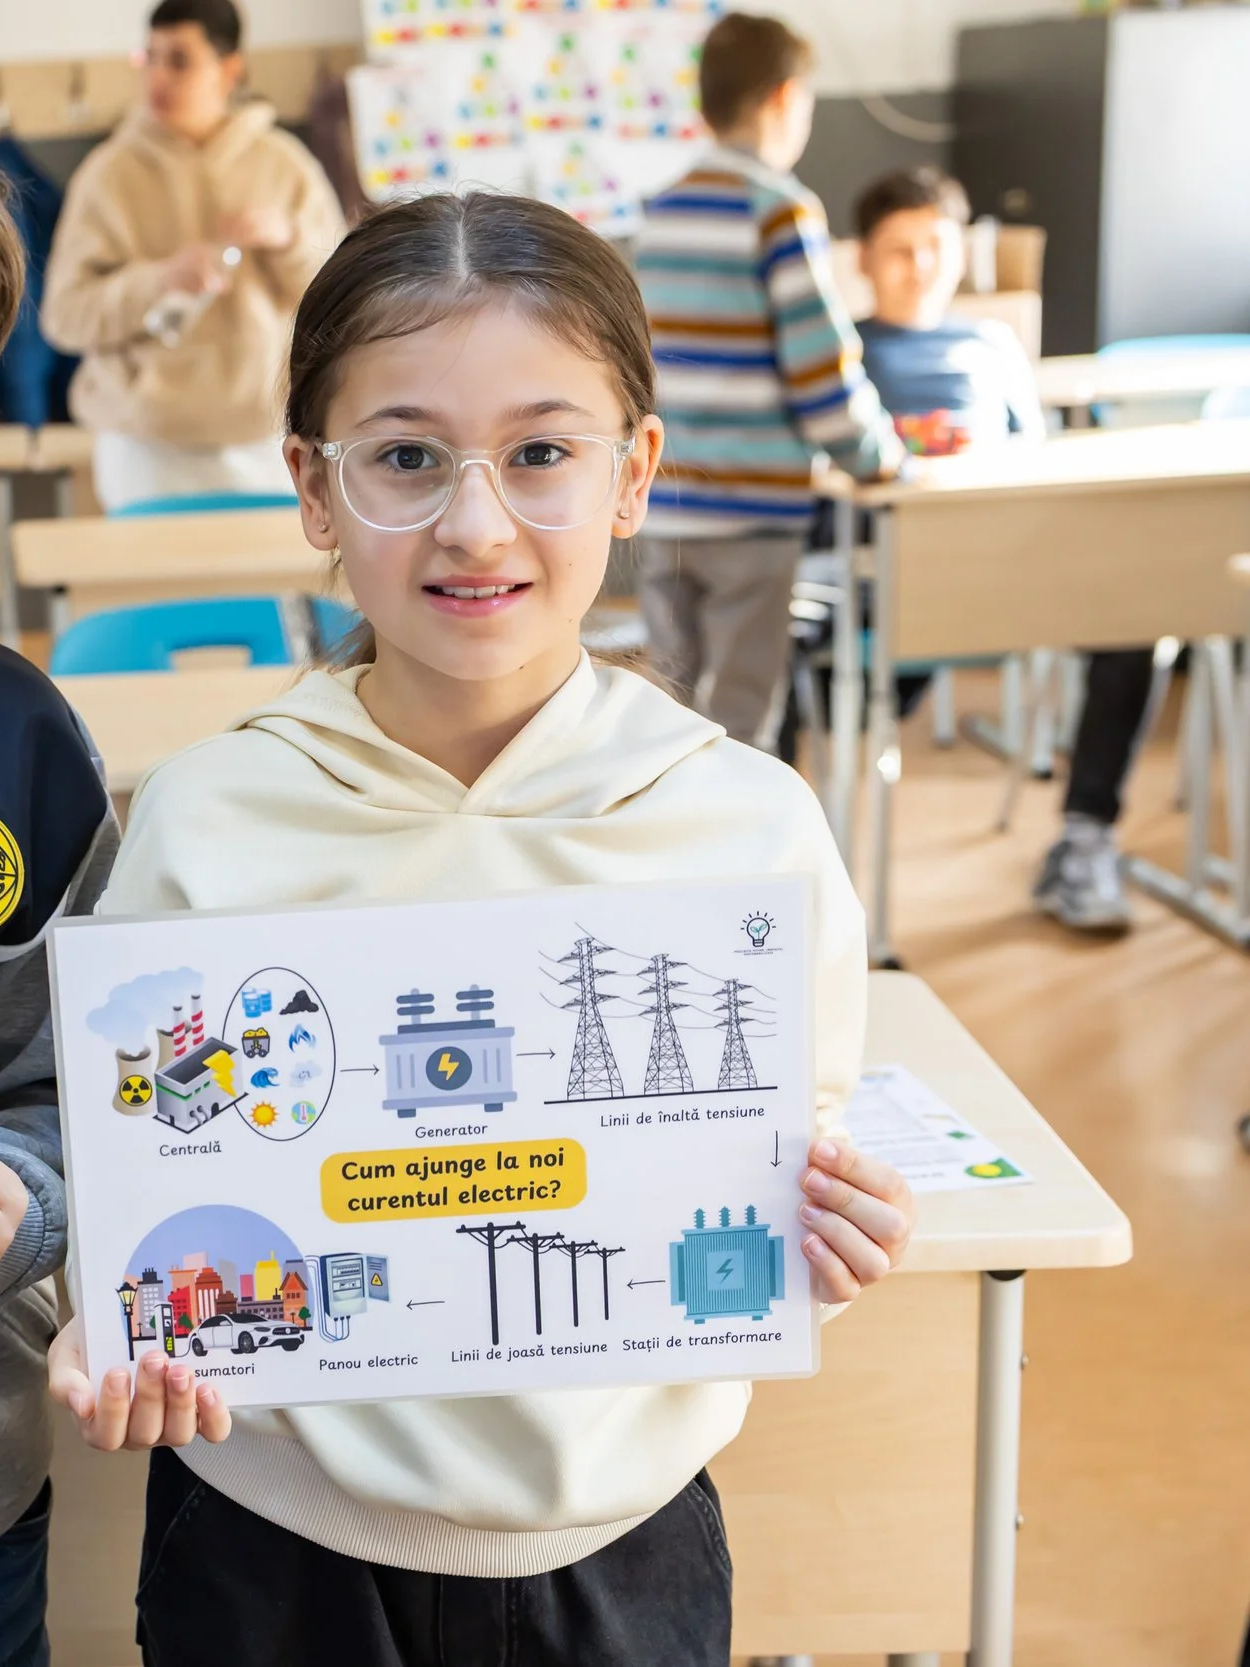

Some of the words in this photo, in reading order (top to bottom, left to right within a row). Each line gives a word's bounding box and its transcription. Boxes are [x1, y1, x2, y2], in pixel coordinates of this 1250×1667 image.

[600, 1113, 630, 1127] Linii
[636, 1111, 652, 1125] de
[658, 1108, 701, 1123] înaltă
[706, 1105, 765, 1120] tensiune
[415, 1124, 488, 1139] Generator
[159, 1140, 222, 1157] Centrală
[341, 1161, 395, 1181] Cum
[405, 1156, 487, 1181] ajunge
[497, 1151, 520, 1170] la
[529, 1147, 564, 1169] noi
[347, 1186, 448, 1212] curentul
[458, 1179, 561, 1204] electric?
[666, 1335, 682, 1348] de
[688, 1331, 782, 1346] transformare
[451, 1349, 480, 1363] Linii
[486, 1347, 502, 1360] de
[506, 1344, 545, 1362] joasă
[550, 1342, 608, 1356] tensiune
[194, 1363, 255, 1378] sumatori
[319, 1359, 361, 1371] Panou
[367, 1353, 419, 1368] electric
